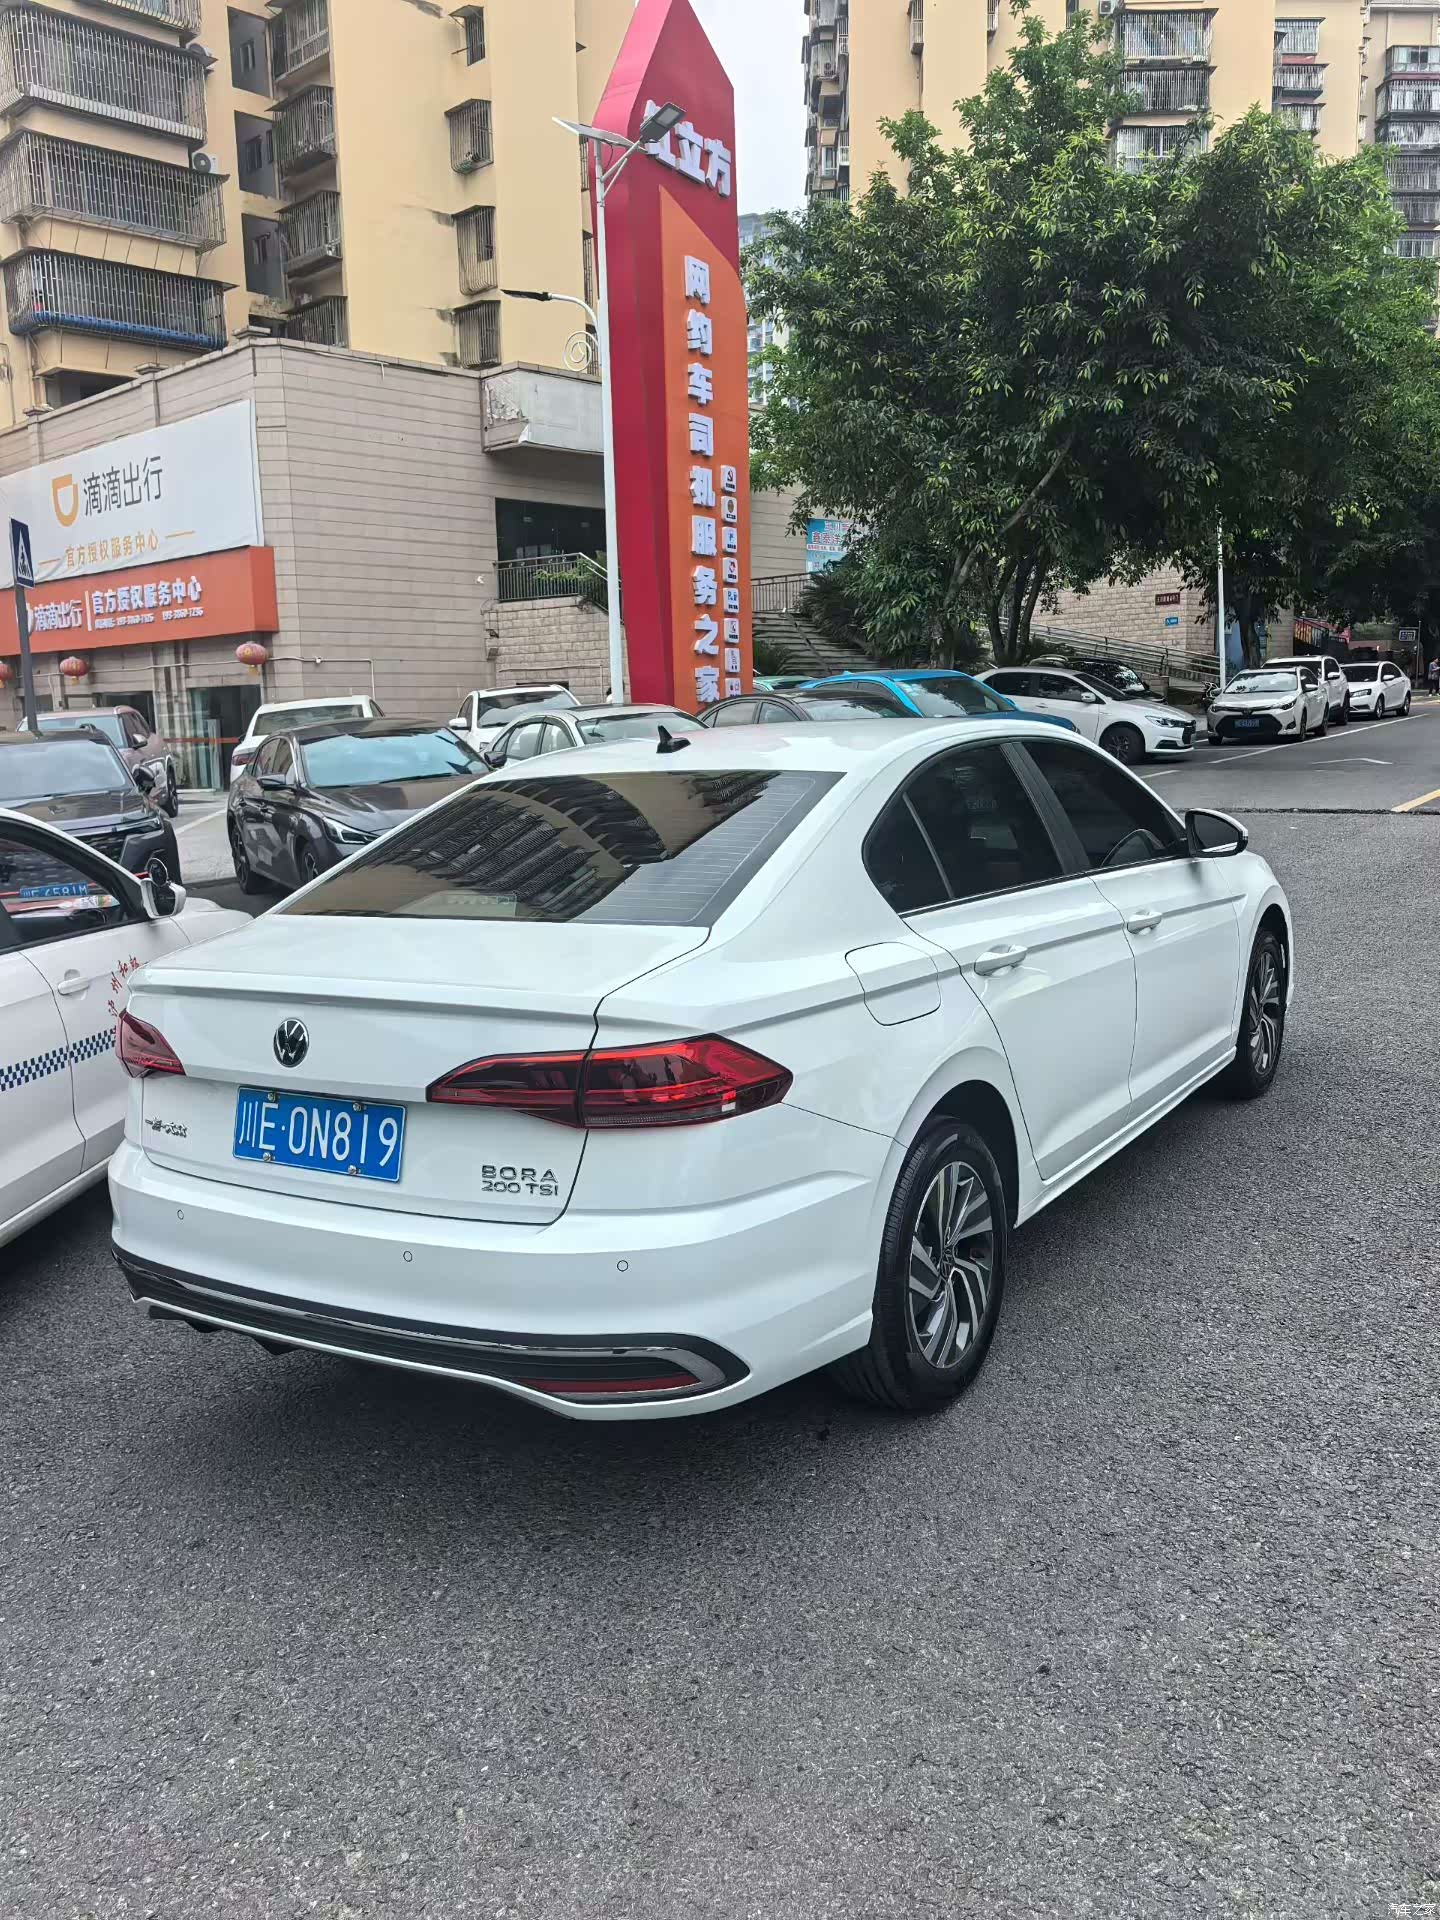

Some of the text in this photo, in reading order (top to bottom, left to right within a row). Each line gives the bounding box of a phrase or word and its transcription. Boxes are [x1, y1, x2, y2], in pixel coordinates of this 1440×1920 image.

[83, 456, 163, 516] 滴滴出行
[684, 255, 720, 703] 网约车司机服务之家
[65, 528, 158, 569] 官方授权服务中心
[34, 600, 83, 632] 滴滴出行
[91, 575, 202, 615] 官方授权服务中心
[481, 1180, 558, 1196] 200 TSI
[482, 1165, 558, 1183] BORA
